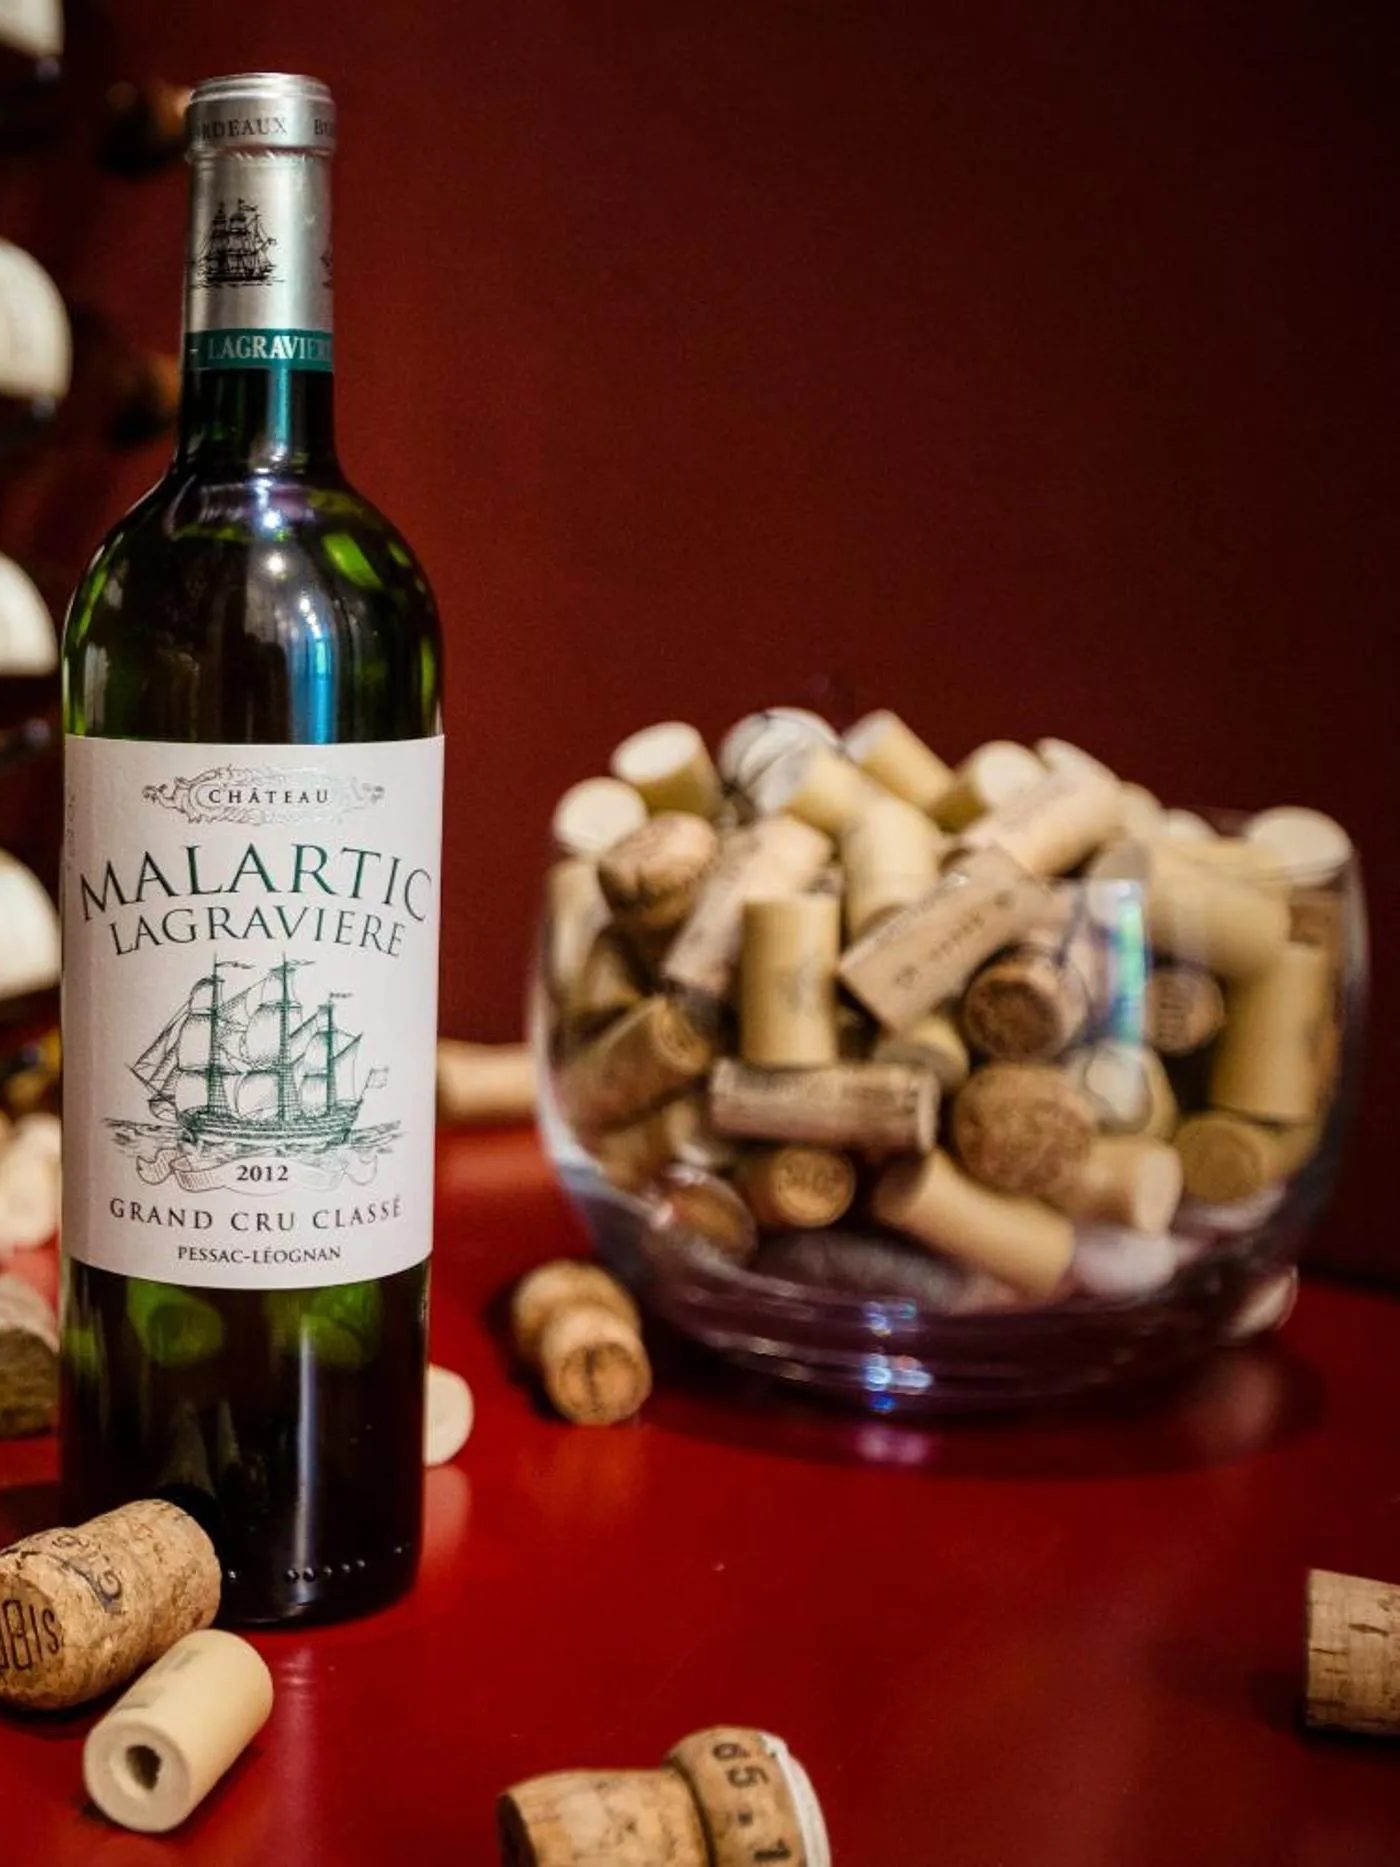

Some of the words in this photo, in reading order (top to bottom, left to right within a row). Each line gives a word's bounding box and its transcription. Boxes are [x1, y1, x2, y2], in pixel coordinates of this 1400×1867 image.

[208, 787, 329, 804] CHÂTEAU
[80, 842, 433, 923] MALARTIC
[109, 905, 406, 957] LAGRAVIERE
[236, 1164, 289, 1182] 2012
[109, 1198, 214, 1230] GRAND
[230, 1211, 296, 1232] CRU
[312, 1194, 403, 1230] CLASSÉ
[177, 1245, 342, 1265] PESSAC-LÉOGNAN
